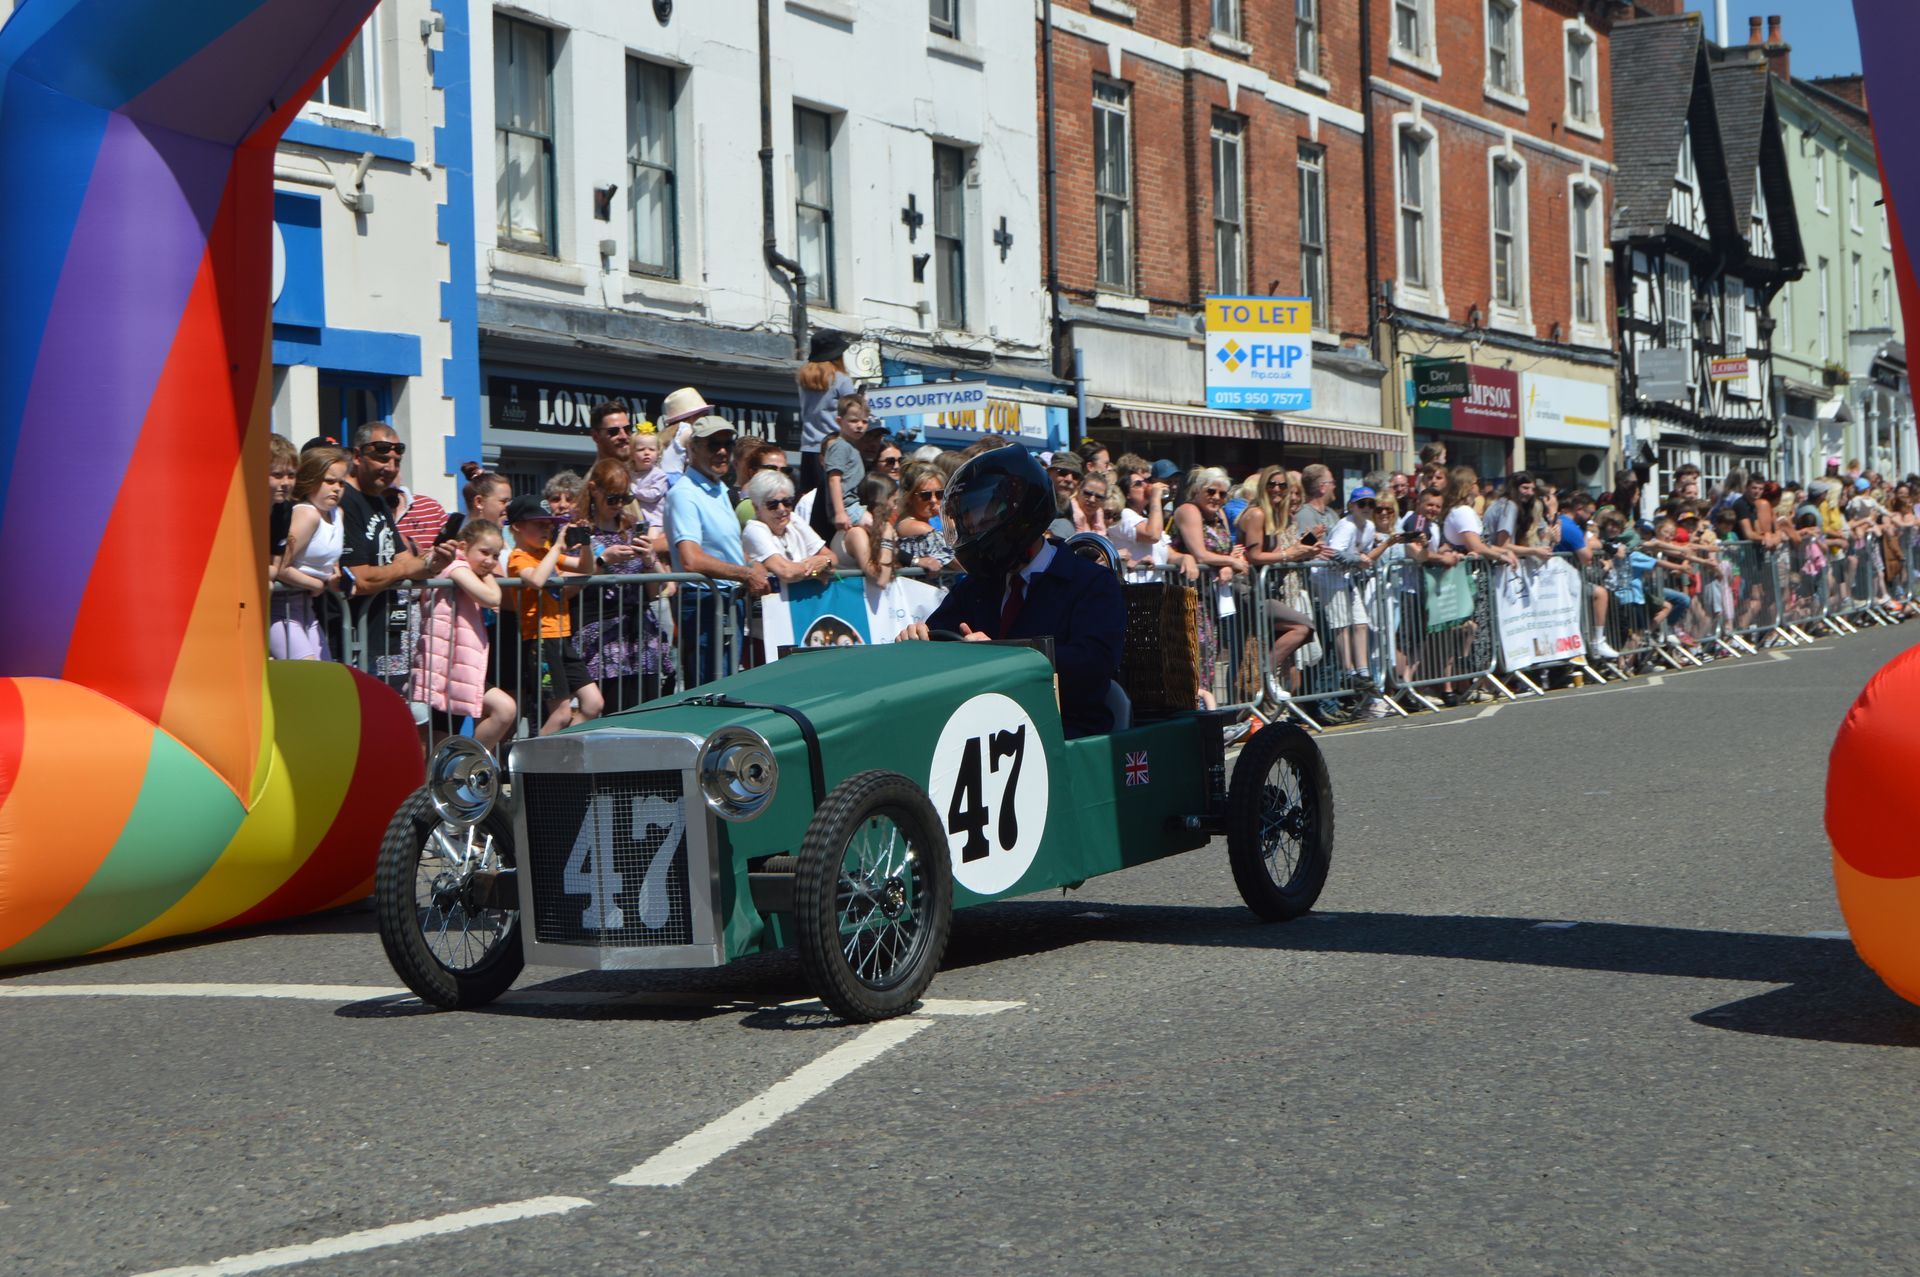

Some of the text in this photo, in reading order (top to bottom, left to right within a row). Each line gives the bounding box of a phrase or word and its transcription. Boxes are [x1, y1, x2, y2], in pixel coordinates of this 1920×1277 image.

[1218, 305, 1299, 325] TO LET
[1250, 344, 1303, 369] FHP
[1250, 370, 1292, 380] fhp.co.uk
[1429, 370, 1450, 382] Dry
[868, 389, 984, 409] ASS COURTYARD
[1215, 391, 1304, 405] 0115 950 7577
[1418, 382, 1465, 395] Cleaning
[1462, 383, 1511, 409] IMPSON
[538, 388, 648, 433] LONN
[983, 399, 1020, 436] YUM
[947, 723, 1026, 864] 47
[563, 794, 687, 930] 47
